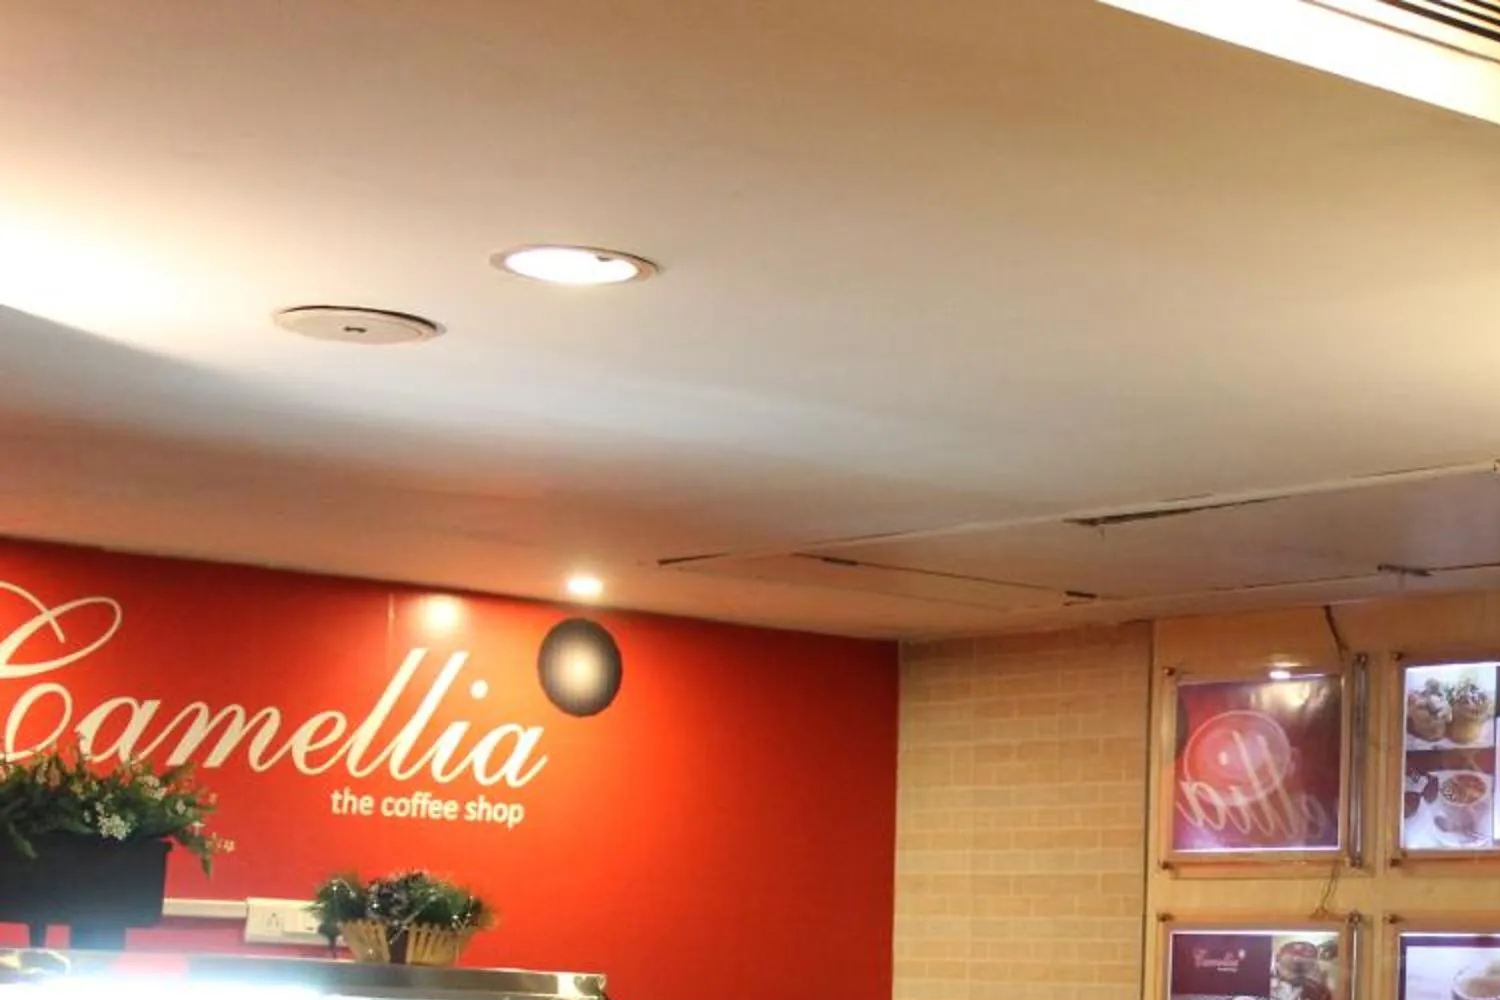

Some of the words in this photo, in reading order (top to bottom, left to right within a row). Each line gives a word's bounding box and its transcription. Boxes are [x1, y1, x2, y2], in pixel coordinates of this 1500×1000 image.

[0, 580, 548, 788] Camellia
[331, 787, 374, 816] the
[380, 791, 459, 820] coffee
[464, 795, 525, 829] shop
